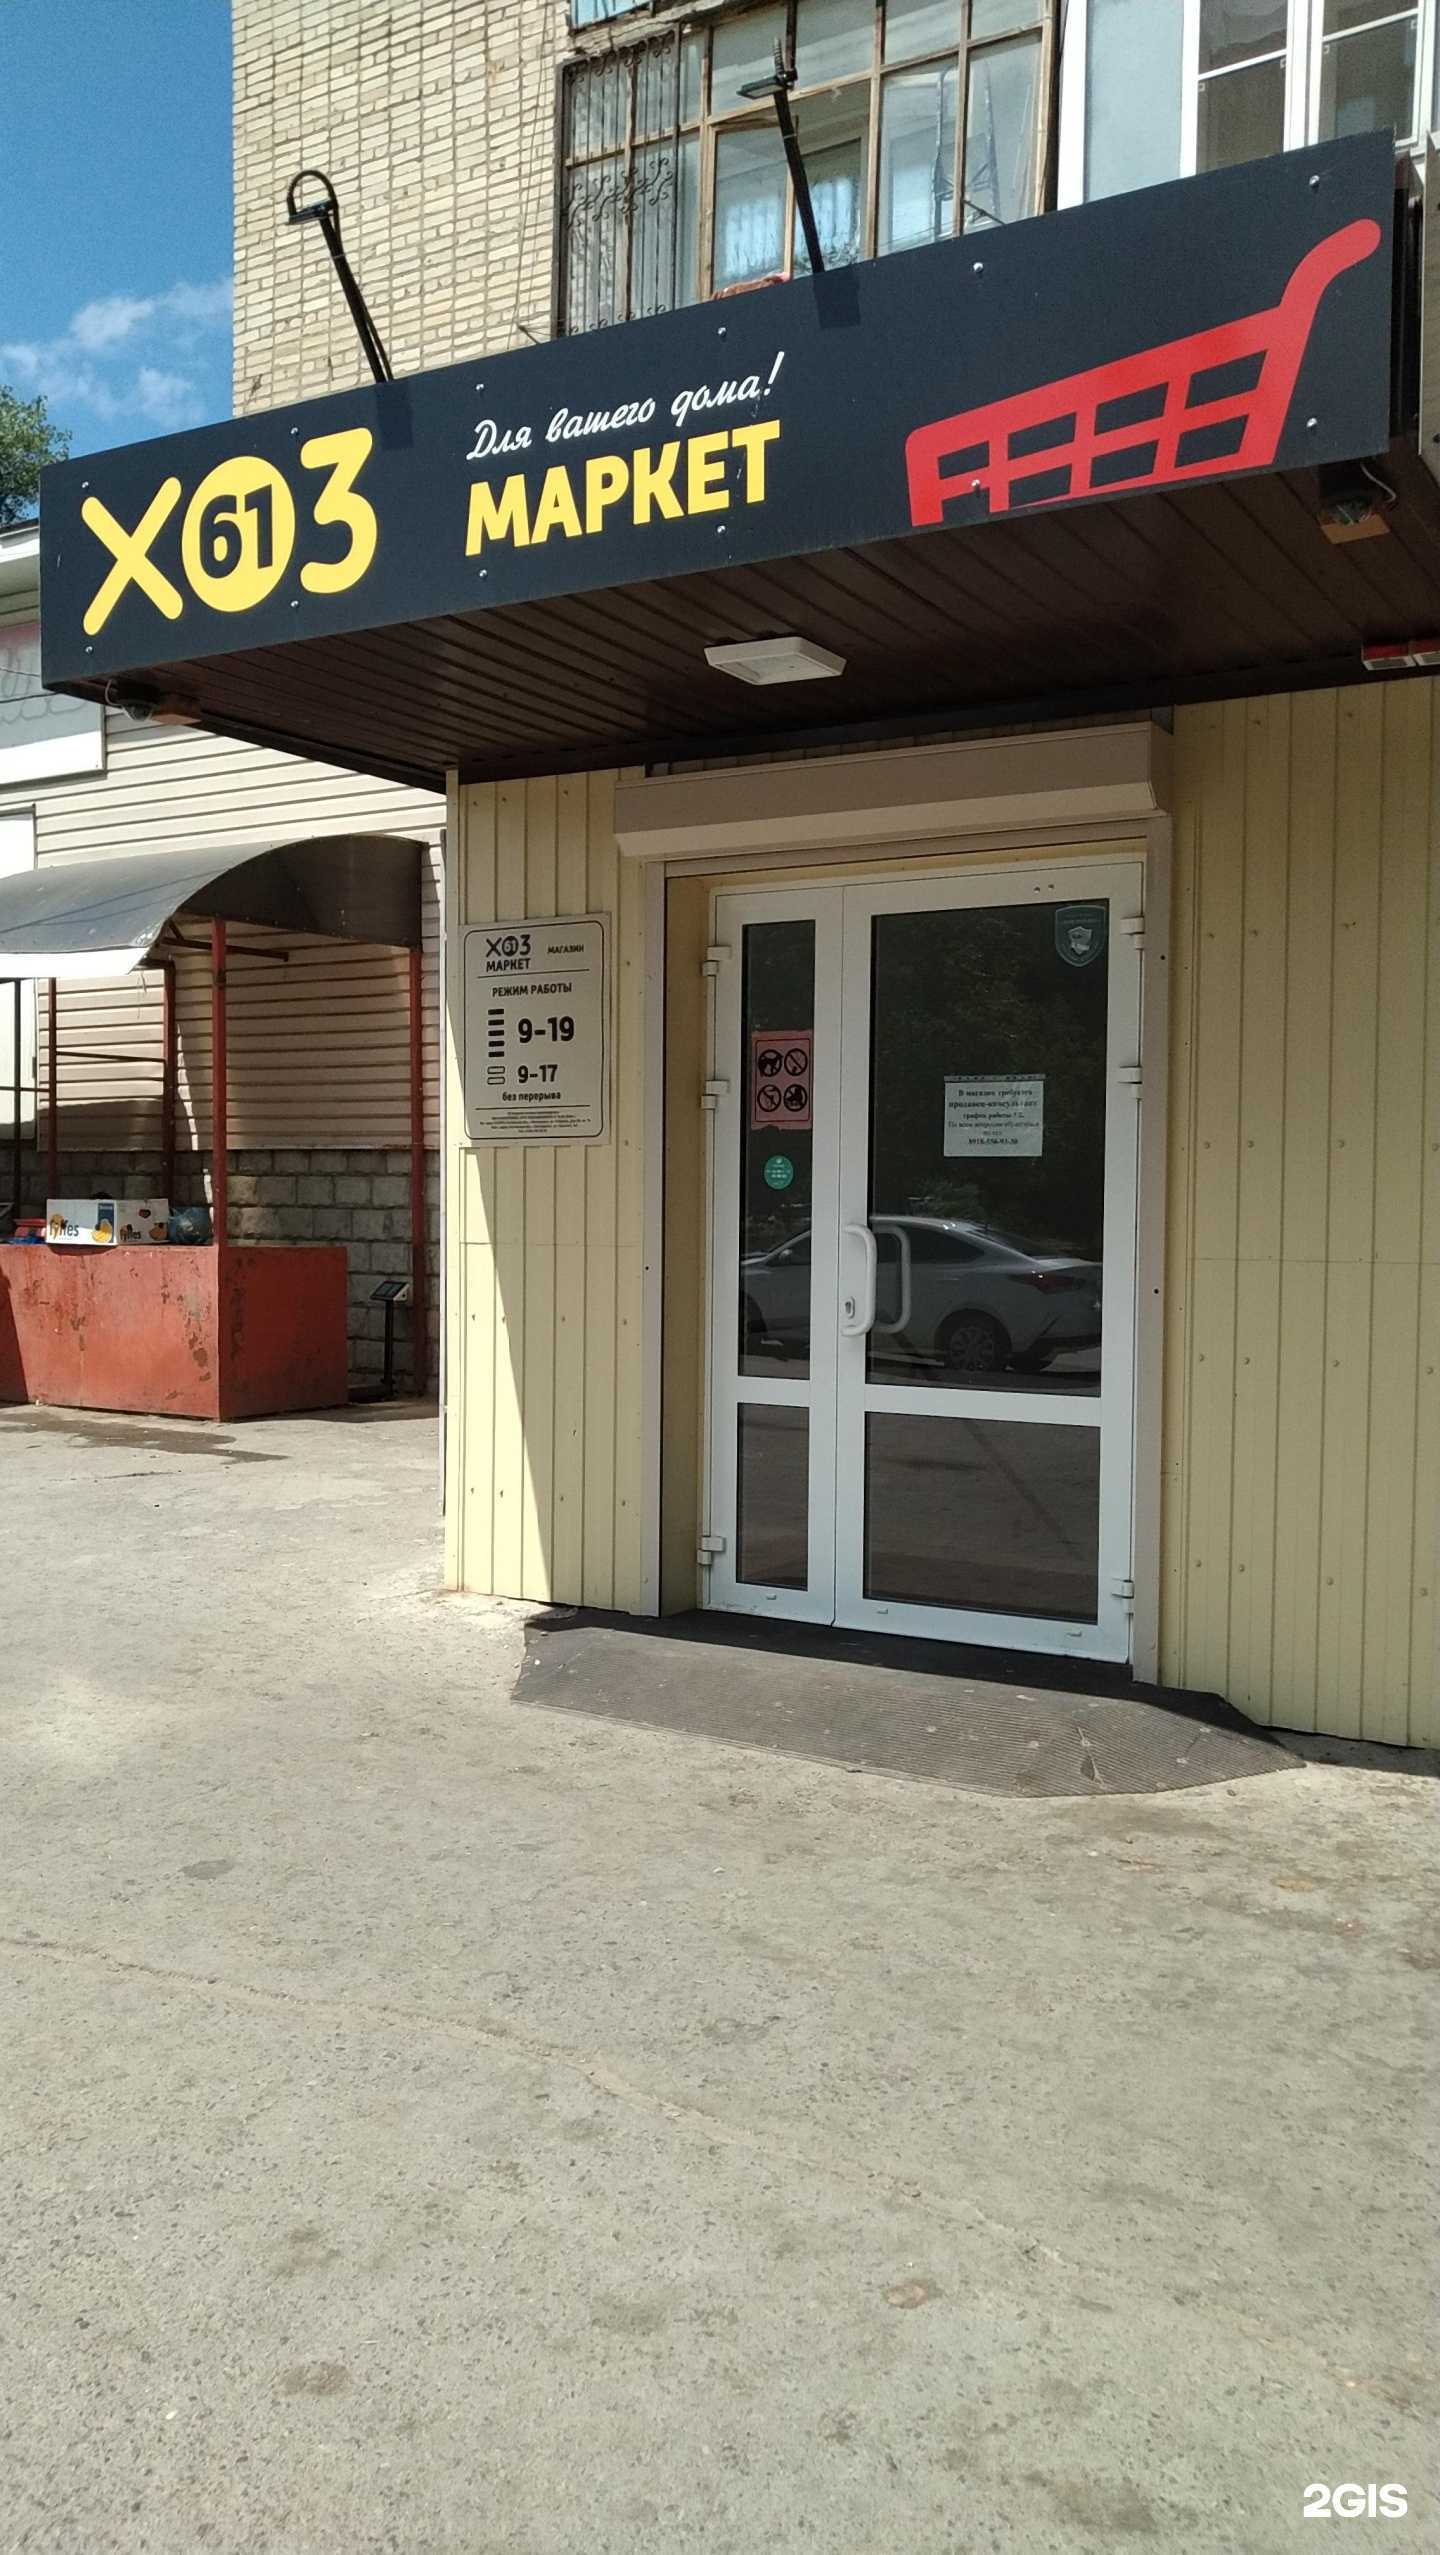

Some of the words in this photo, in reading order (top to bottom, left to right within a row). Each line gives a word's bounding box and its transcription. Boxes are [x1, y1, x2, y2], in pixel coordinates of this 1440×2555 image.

[465, 419, 533, 461] Для
[545, 397, 656, 442] вашего
[670, 351, 785, 427] дома!
[465, 419, 781, 557] МАРКЕТ
[200, 483, 273, 579] 61
[547, 944, 585, 954] МАГАЗИН
[486, 958, 531, 972] МАРКЕТ
[492, 985, 528, 997] РЕЖИМ
[530, 982, 572, 995] РАБОТЫ
[518, 1016, 575, 1043] 9-19
[518, 1064, 558, 1083] 9-17
[502, 1091, 516, 1101] без
[518, 1092, 561, 1103] перерыва
